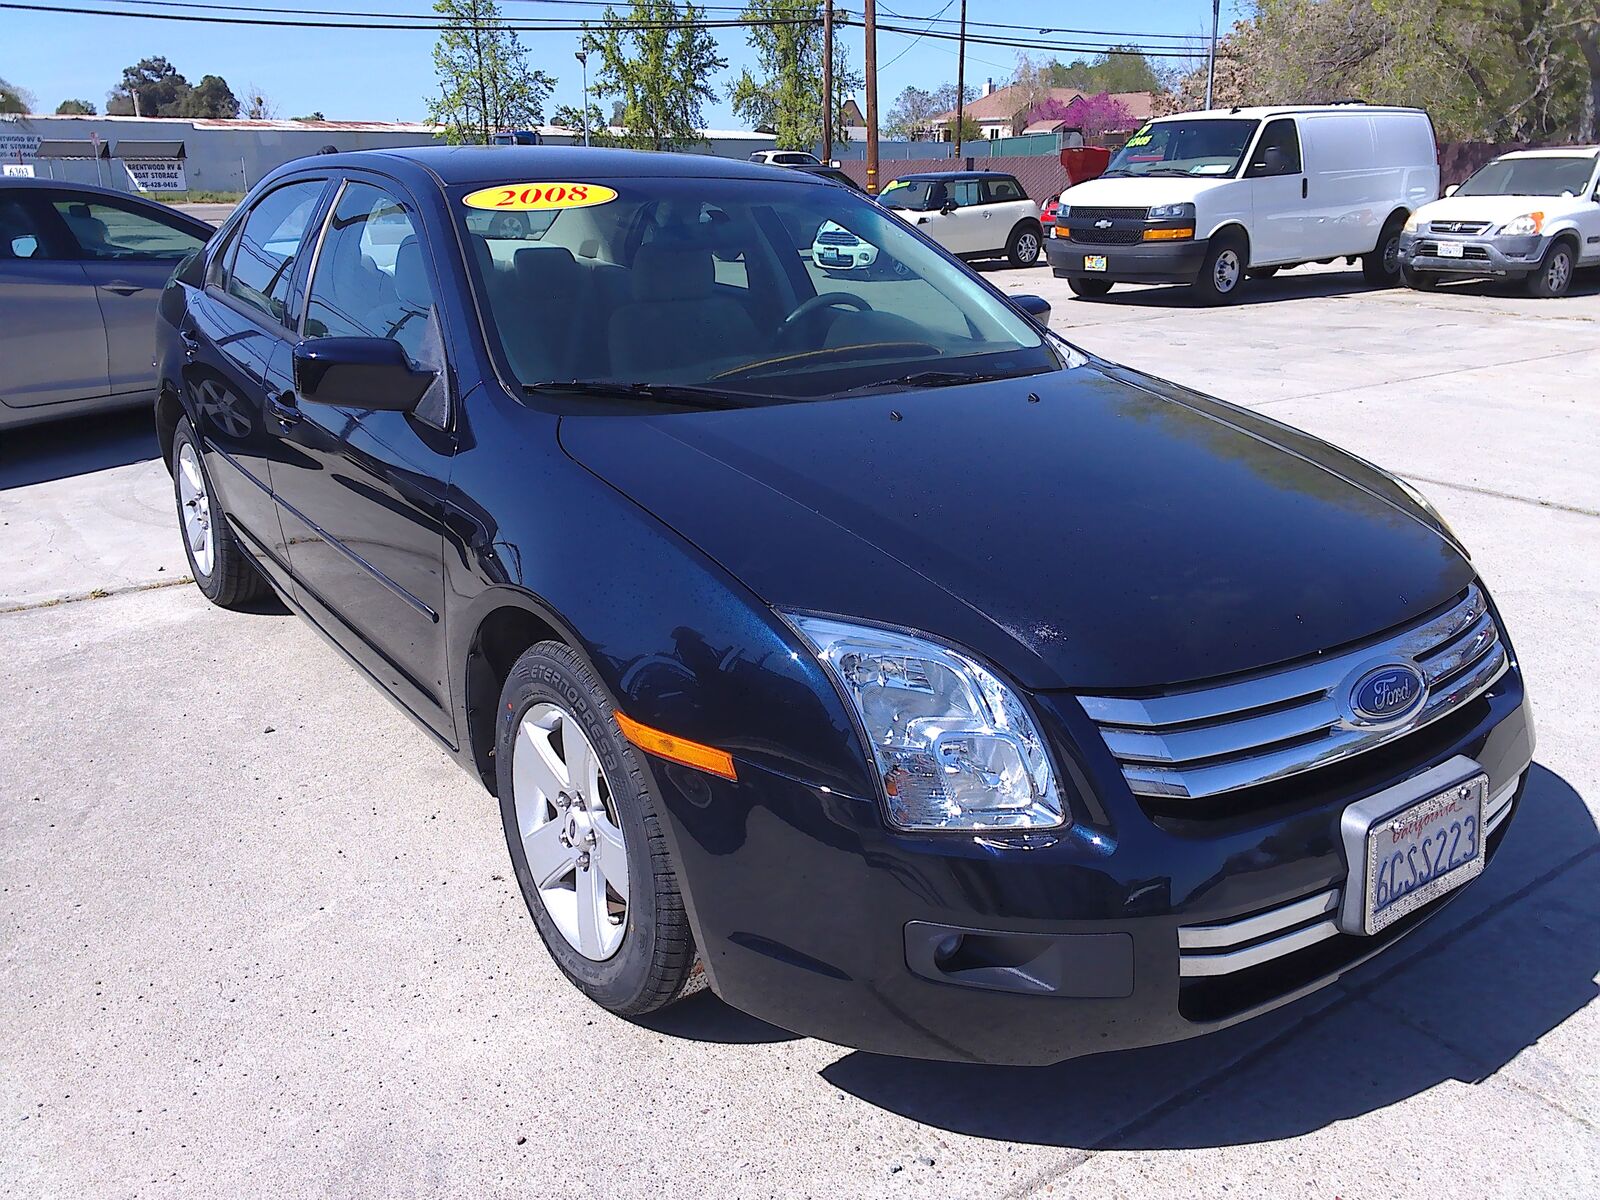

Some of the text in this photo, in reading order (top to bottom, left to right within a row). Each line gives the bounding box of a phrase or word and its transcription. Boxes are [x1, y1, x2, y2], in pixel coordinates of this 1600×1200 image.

[127, 163, 166, 171] BRENTWOOD
[177, 163, 182, 171] &
[495, 186, 589, 207] 2008
[1374, 675, 1411, 711] Ford
[1376, 815, 1476, 908] 6CSS223
